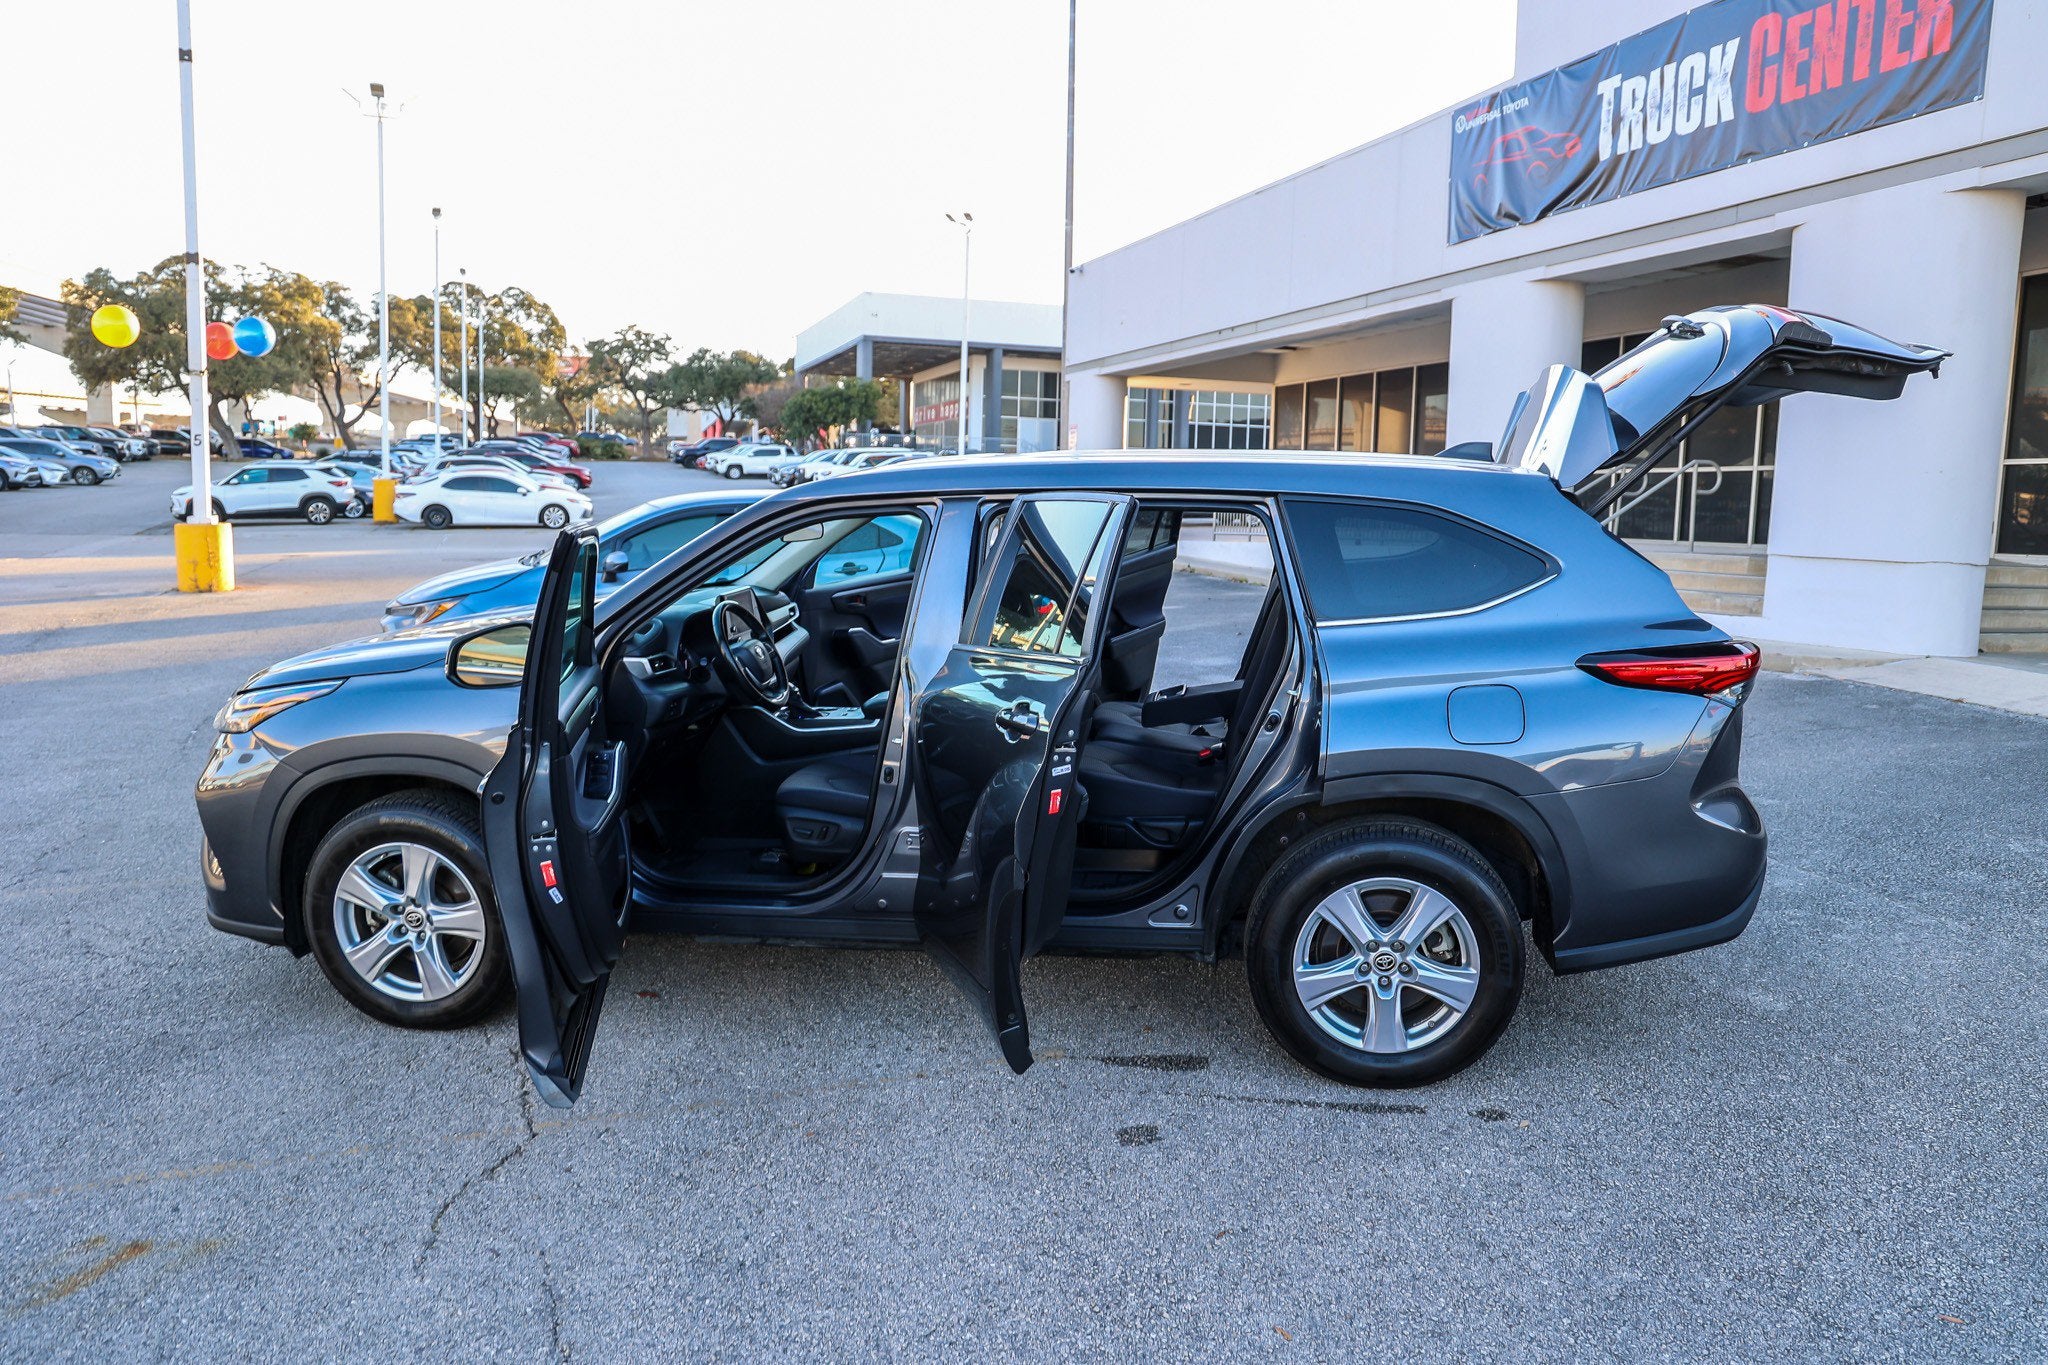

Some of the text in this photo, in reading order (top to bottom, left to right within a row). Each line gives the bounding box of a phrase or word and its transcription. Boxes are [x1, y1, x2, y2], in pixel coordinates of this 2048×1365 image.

[1597, 0, 1954, 162] TRUCK CENTER
[1465, 107, 1502, 131] UNIVERSAL
[1502, 97, 1529, 115] TOYOTA
[193, 433, 202, 446] 5
